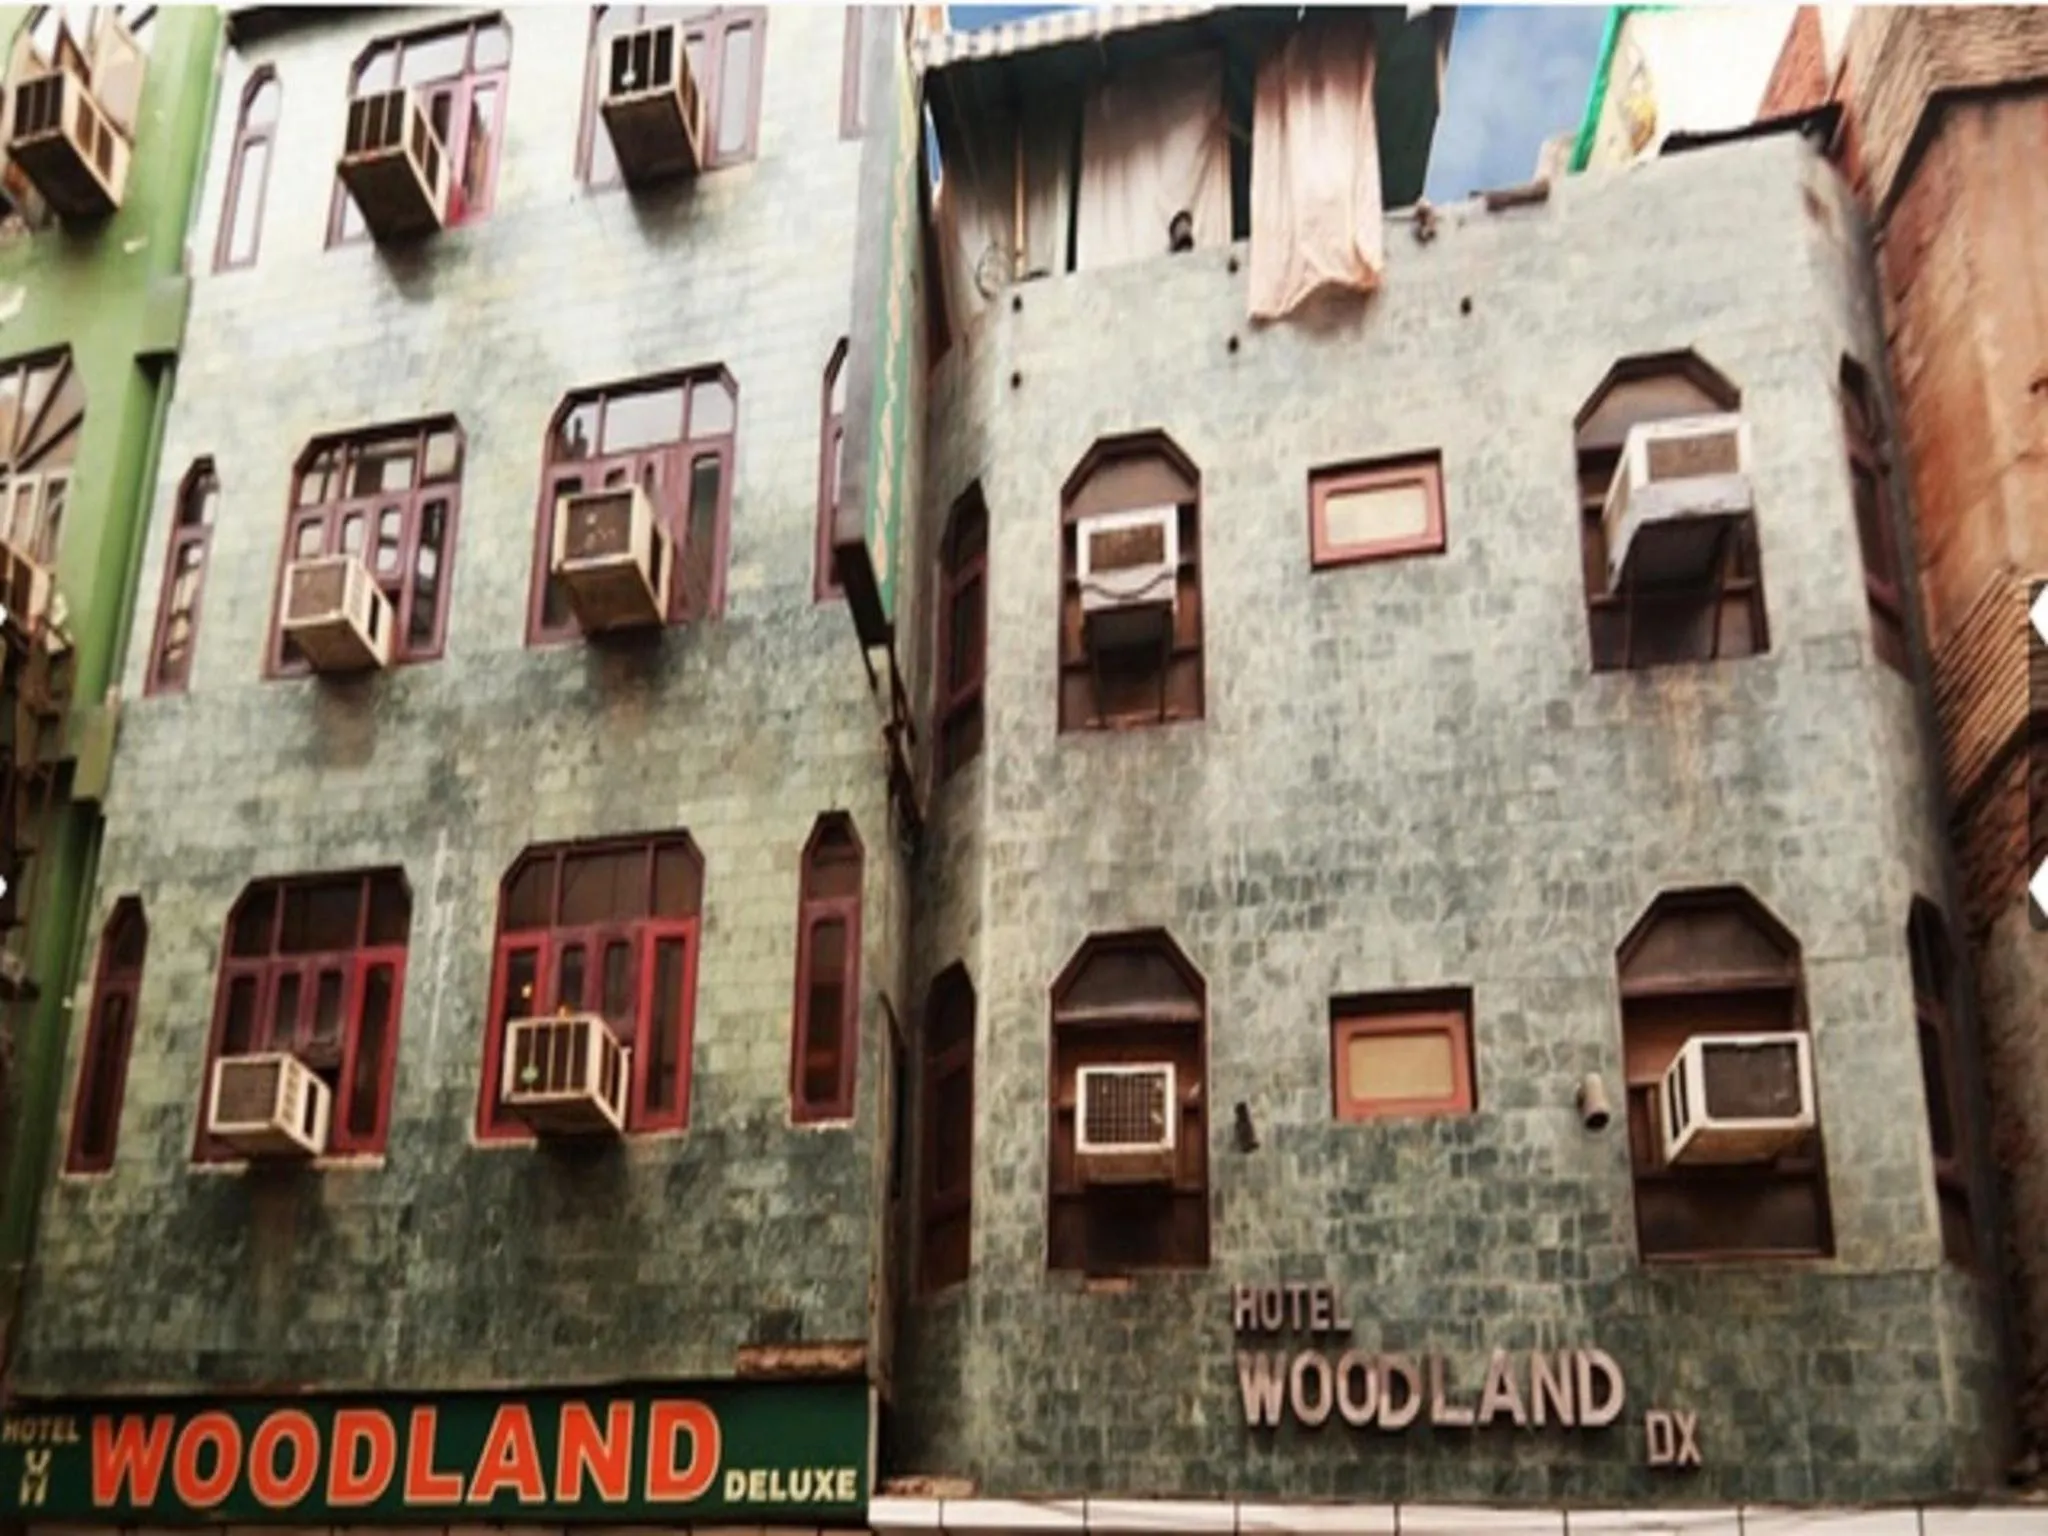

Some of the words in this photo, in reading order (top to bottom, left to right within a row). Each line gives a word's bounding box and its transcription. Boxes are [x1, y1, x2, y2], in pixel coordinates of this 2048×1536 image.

[1233, 1282, 1352, 1332] HOTEL
[1237, 1347, 1626, 1431] WOODLAND
[2, 1415, 80, 1444] HOTEL
[91, 1399, 722, 1507] WOODLAND
[723, 1469, 858, 1503] DELUXE
[1645, 1408, 1702, 1467] DX
